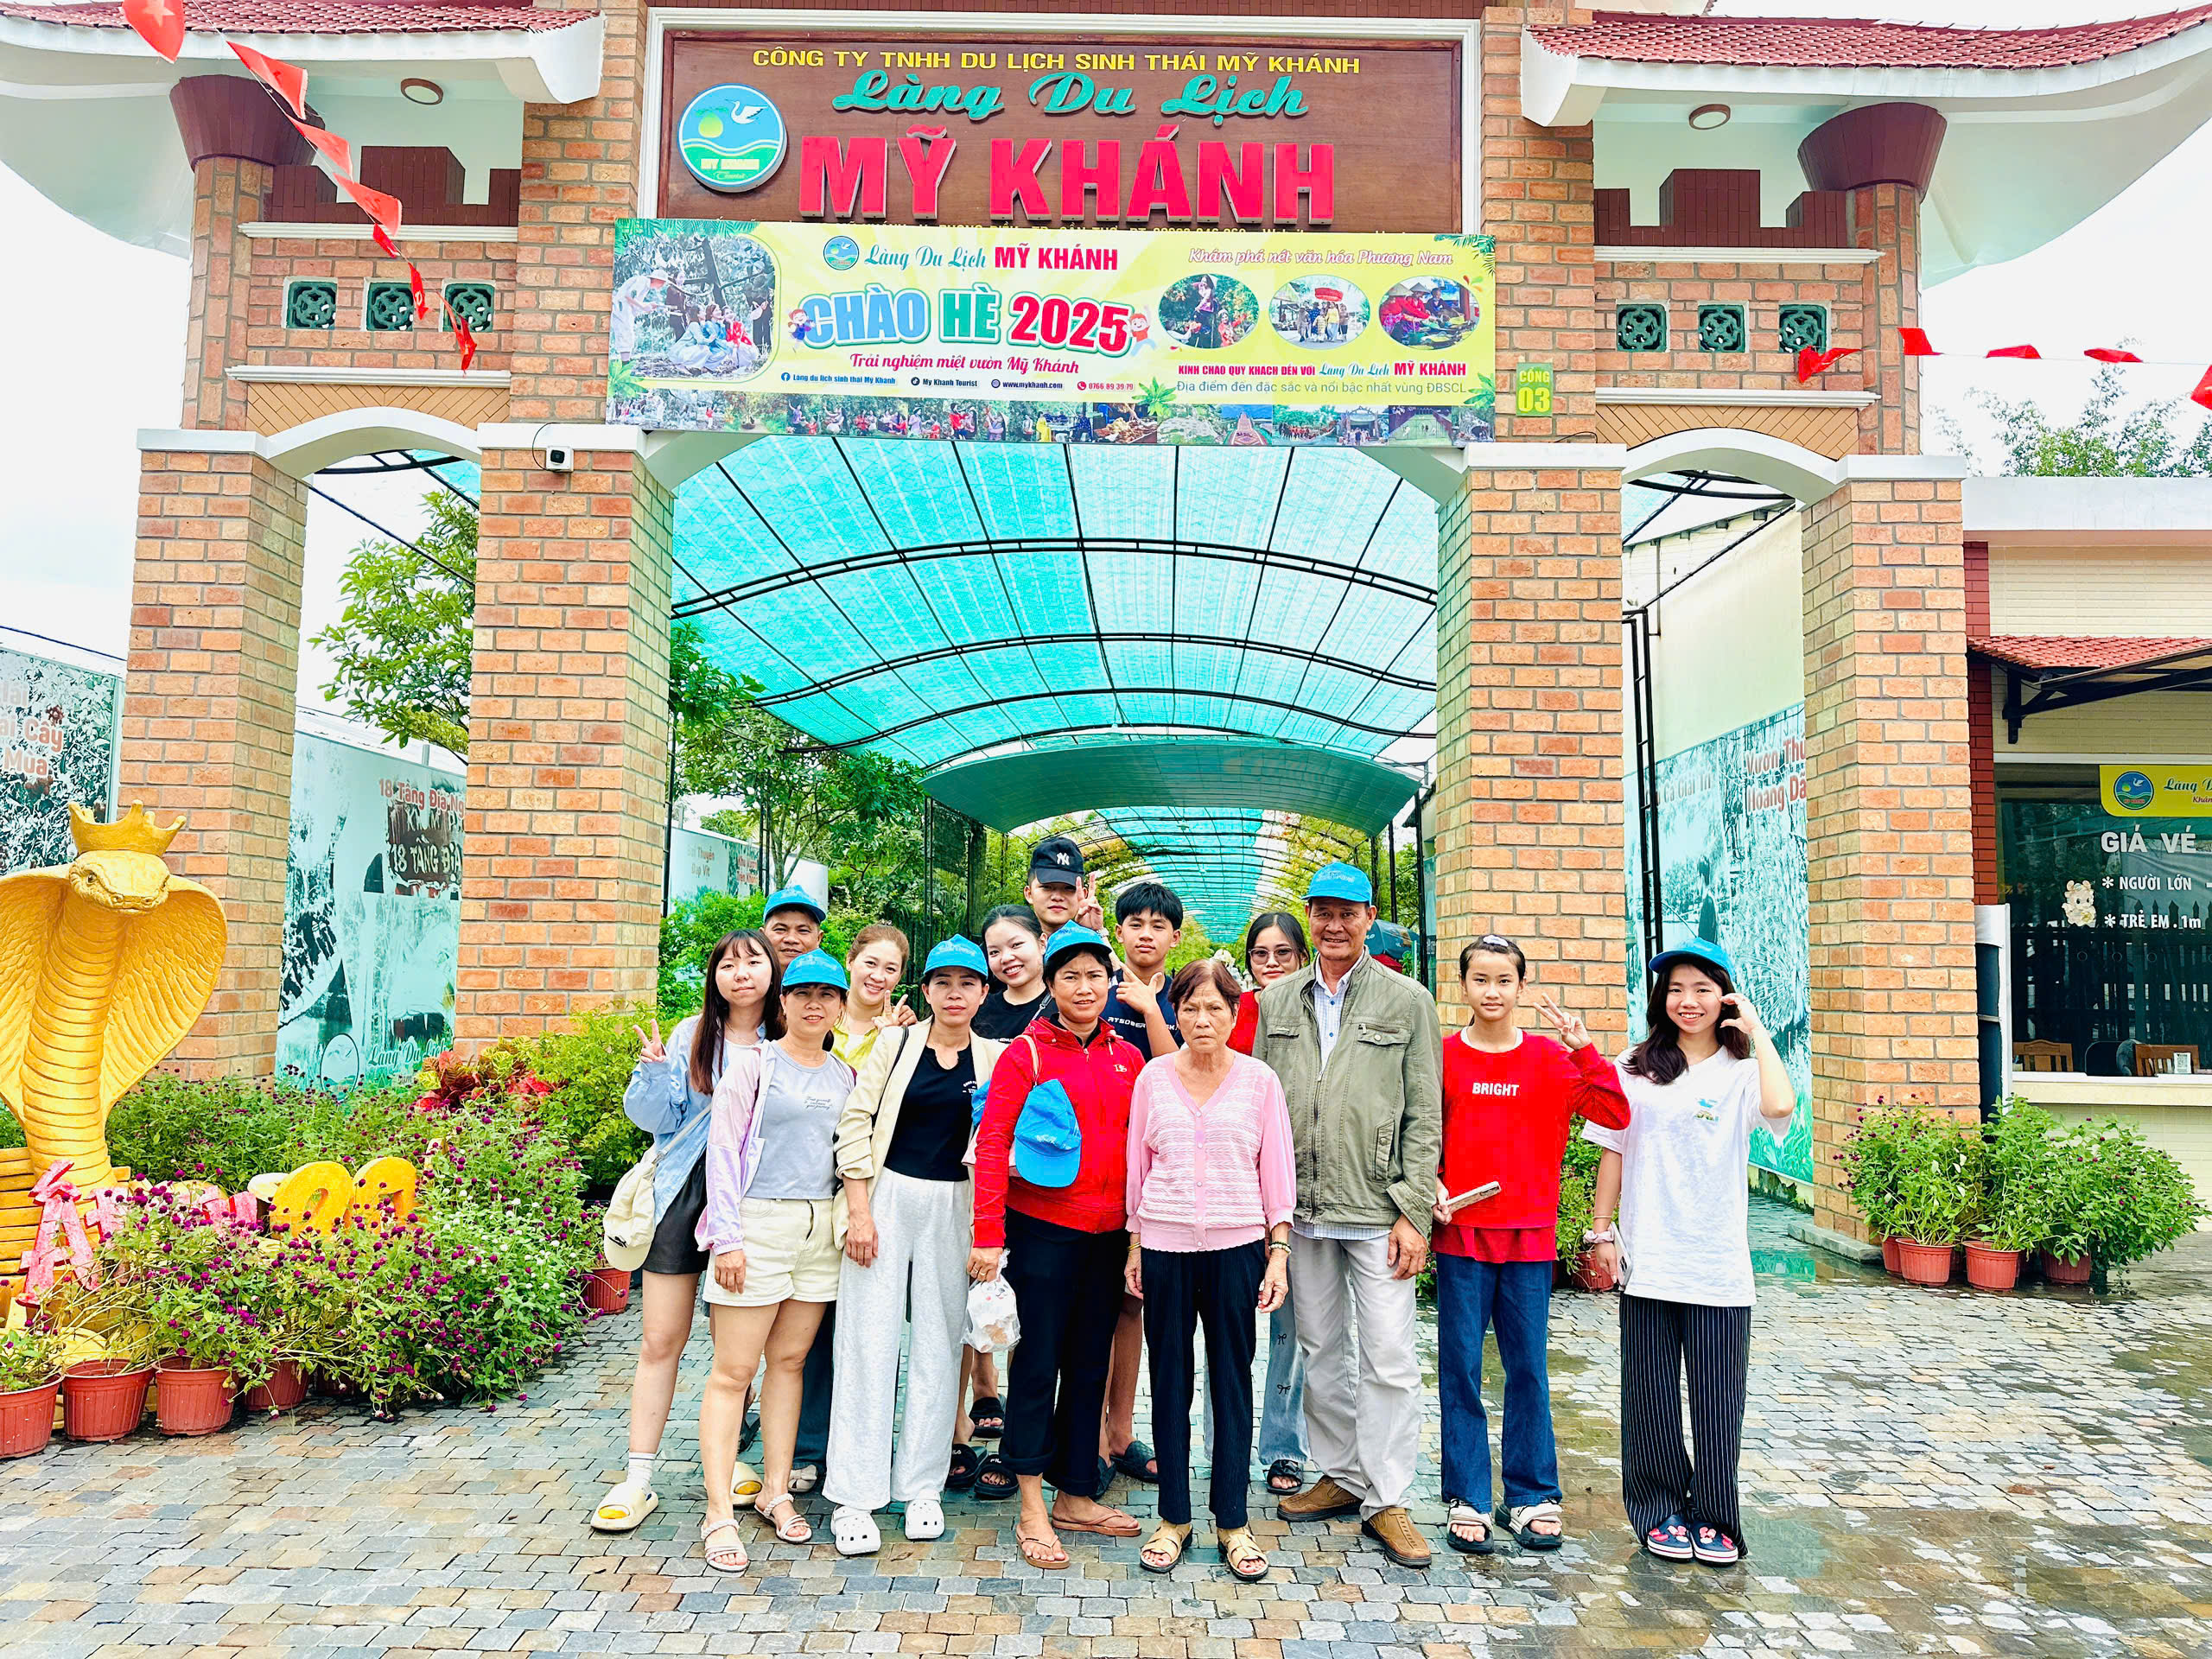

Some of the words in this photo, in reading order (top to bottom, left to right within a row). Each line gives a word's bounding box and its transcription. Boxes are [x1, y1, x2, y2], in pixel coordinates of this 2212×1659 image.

[753, 46, 823, 67] CÔNG
[833, 50, 869, 67] TY
[880, 51, 950, 68] TNHH
[961, 52, 996, 69] DU
[1007, 53, 1064, 72] LỊCH
[1075, 54, 1135, 70] SINH
[1145, 50, 1205, 71] THÁI
[1217, 51, 1259, 72] MỸ
[1268, 51, 1360, 73] KHÁNH
[831, 69, 1005, 123] Làng
[1028, 72, 1135, 116] Du
[1160, 74, 1308, 127] Lịch
[799, 124, 957, 219] MỸ
[989, 124, 1334, 225] KHÁNH
[864, 244, 908, 270] Làng
[915, 246, 943, 267] Du
[948, 246, 986, 272] Lịch
[995, 243, 1031, 269] MỸ
[1039, 243, 1118, 270] KHÁNH
[1189, 247, 1233, 263] Khám
[1235, 249, 1265, 266] phá
[1325, 250, 1354, 264] hóa
[1418, 251, 1453, 264] Nam
[801, 283, 929, 348] CHÀO
[940, 283, 1001, 343] HÈ
[1009, 292, 1131, 356] 2025
[1395, 360, 1415, 376] MỸ
[1420, 359, 1465, 376] KHÁNH
[956, 378, 977, 387] Tourist
[1305, 382, 1317, 392] và
[1427, 382, 1466, 392] ĐBSCL
[1518, 386, 1550, 413] 03
[24, 718, 63, 752] Cây
[3, 746, 48, 775] Mùa
[380, 779, 393, 798] 18
[1747, 785, 1784, 812] Hoang
[2101, 823, 2148, 853] GIÁ
[2161, 825, 2196, 854] VÉ
[391, 843, 408, 873] 18
[2119, 873, 2161, 891] NGƯỜI
[2167, 874, 2192, 891] LỚN
[2120, 909, 2147, 929] TRẺ
[1471, 1082, 1520, 1097] BRIGHT
